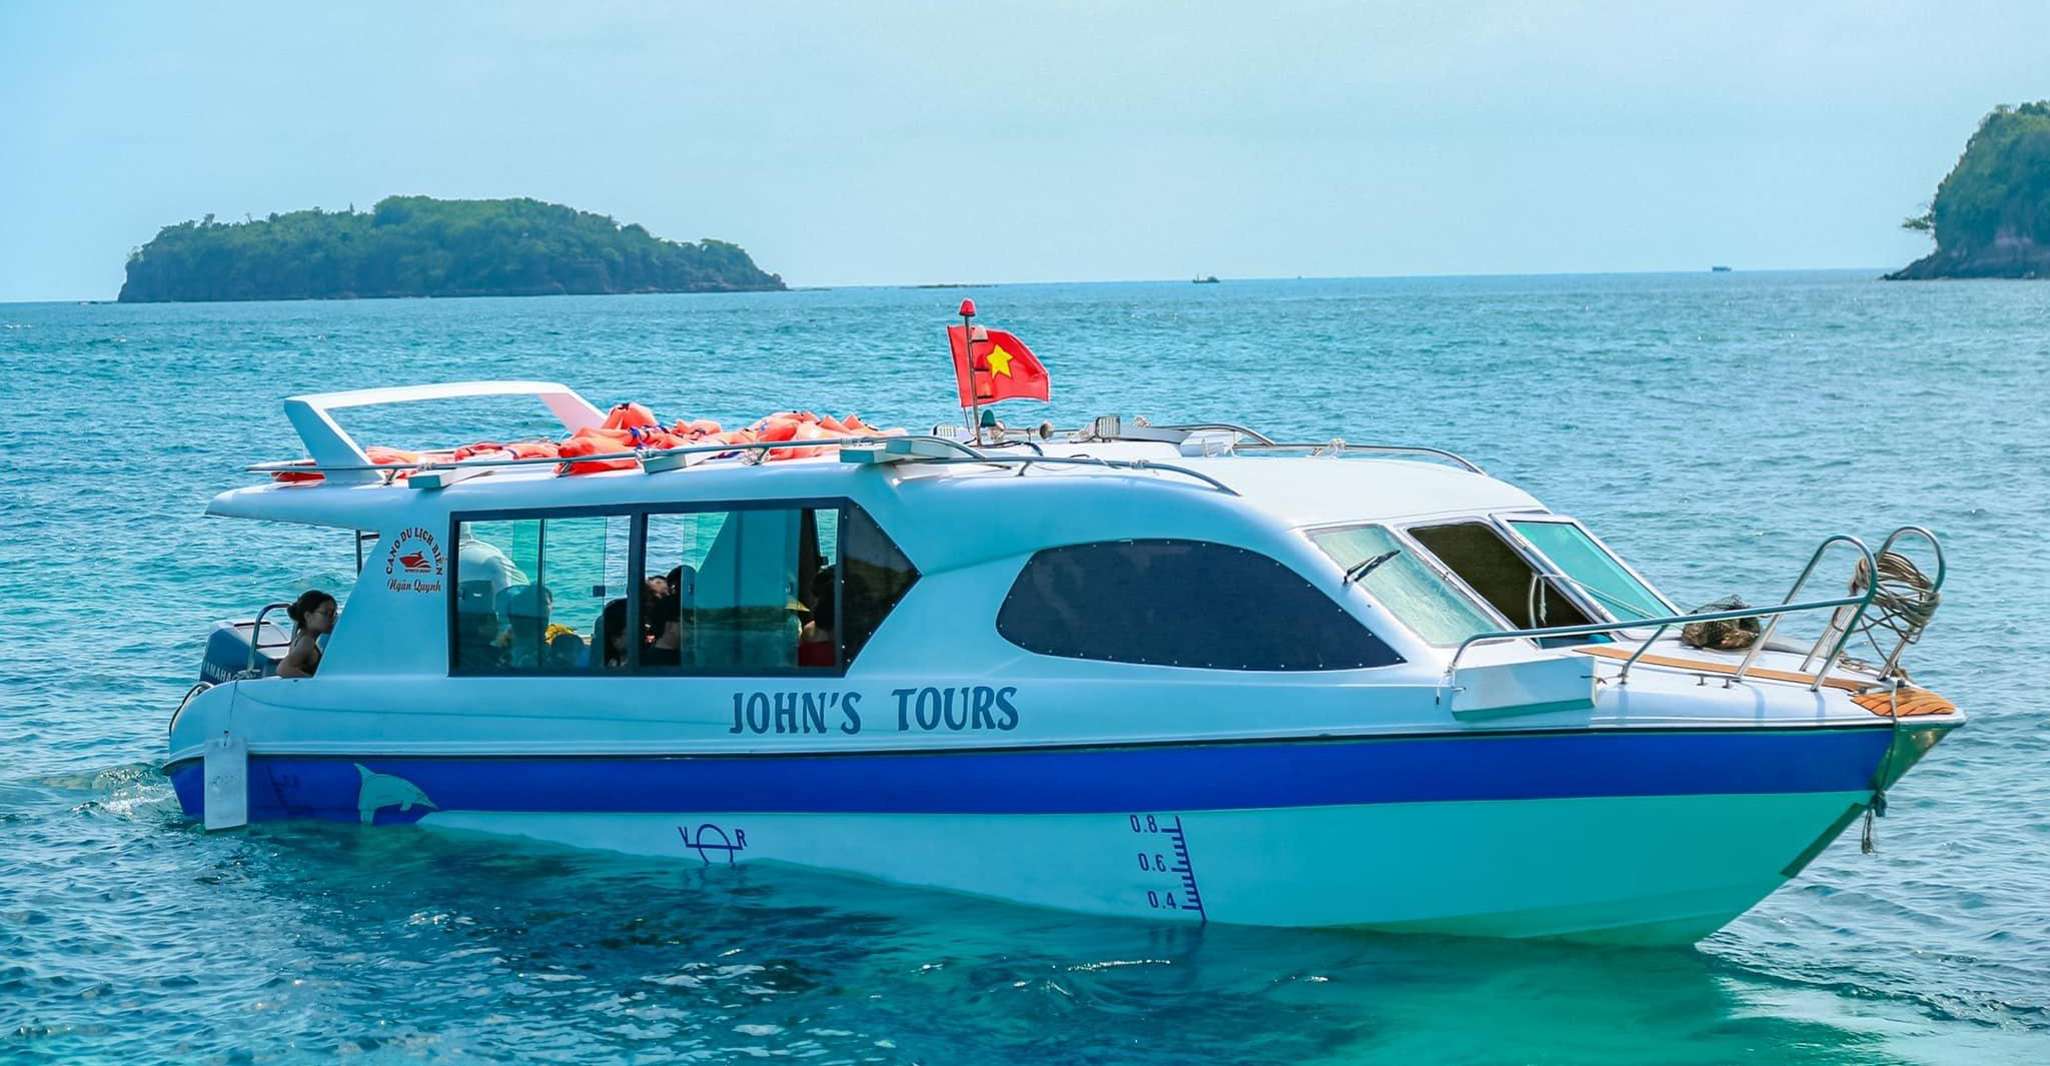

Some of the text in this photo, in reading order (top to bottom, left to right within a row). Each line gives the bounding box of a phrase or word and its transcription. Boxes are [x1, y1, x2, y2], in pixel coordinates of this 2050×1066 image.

[400, 528, 413, 542] DU
[729, 686, 1019, 735] JOHN'S TOURS
[1130, 814, 1158, 833] 0.8
[1138, 852, 1167, 872] 0.6
[1147, 890, 1177, 910] 0.4
